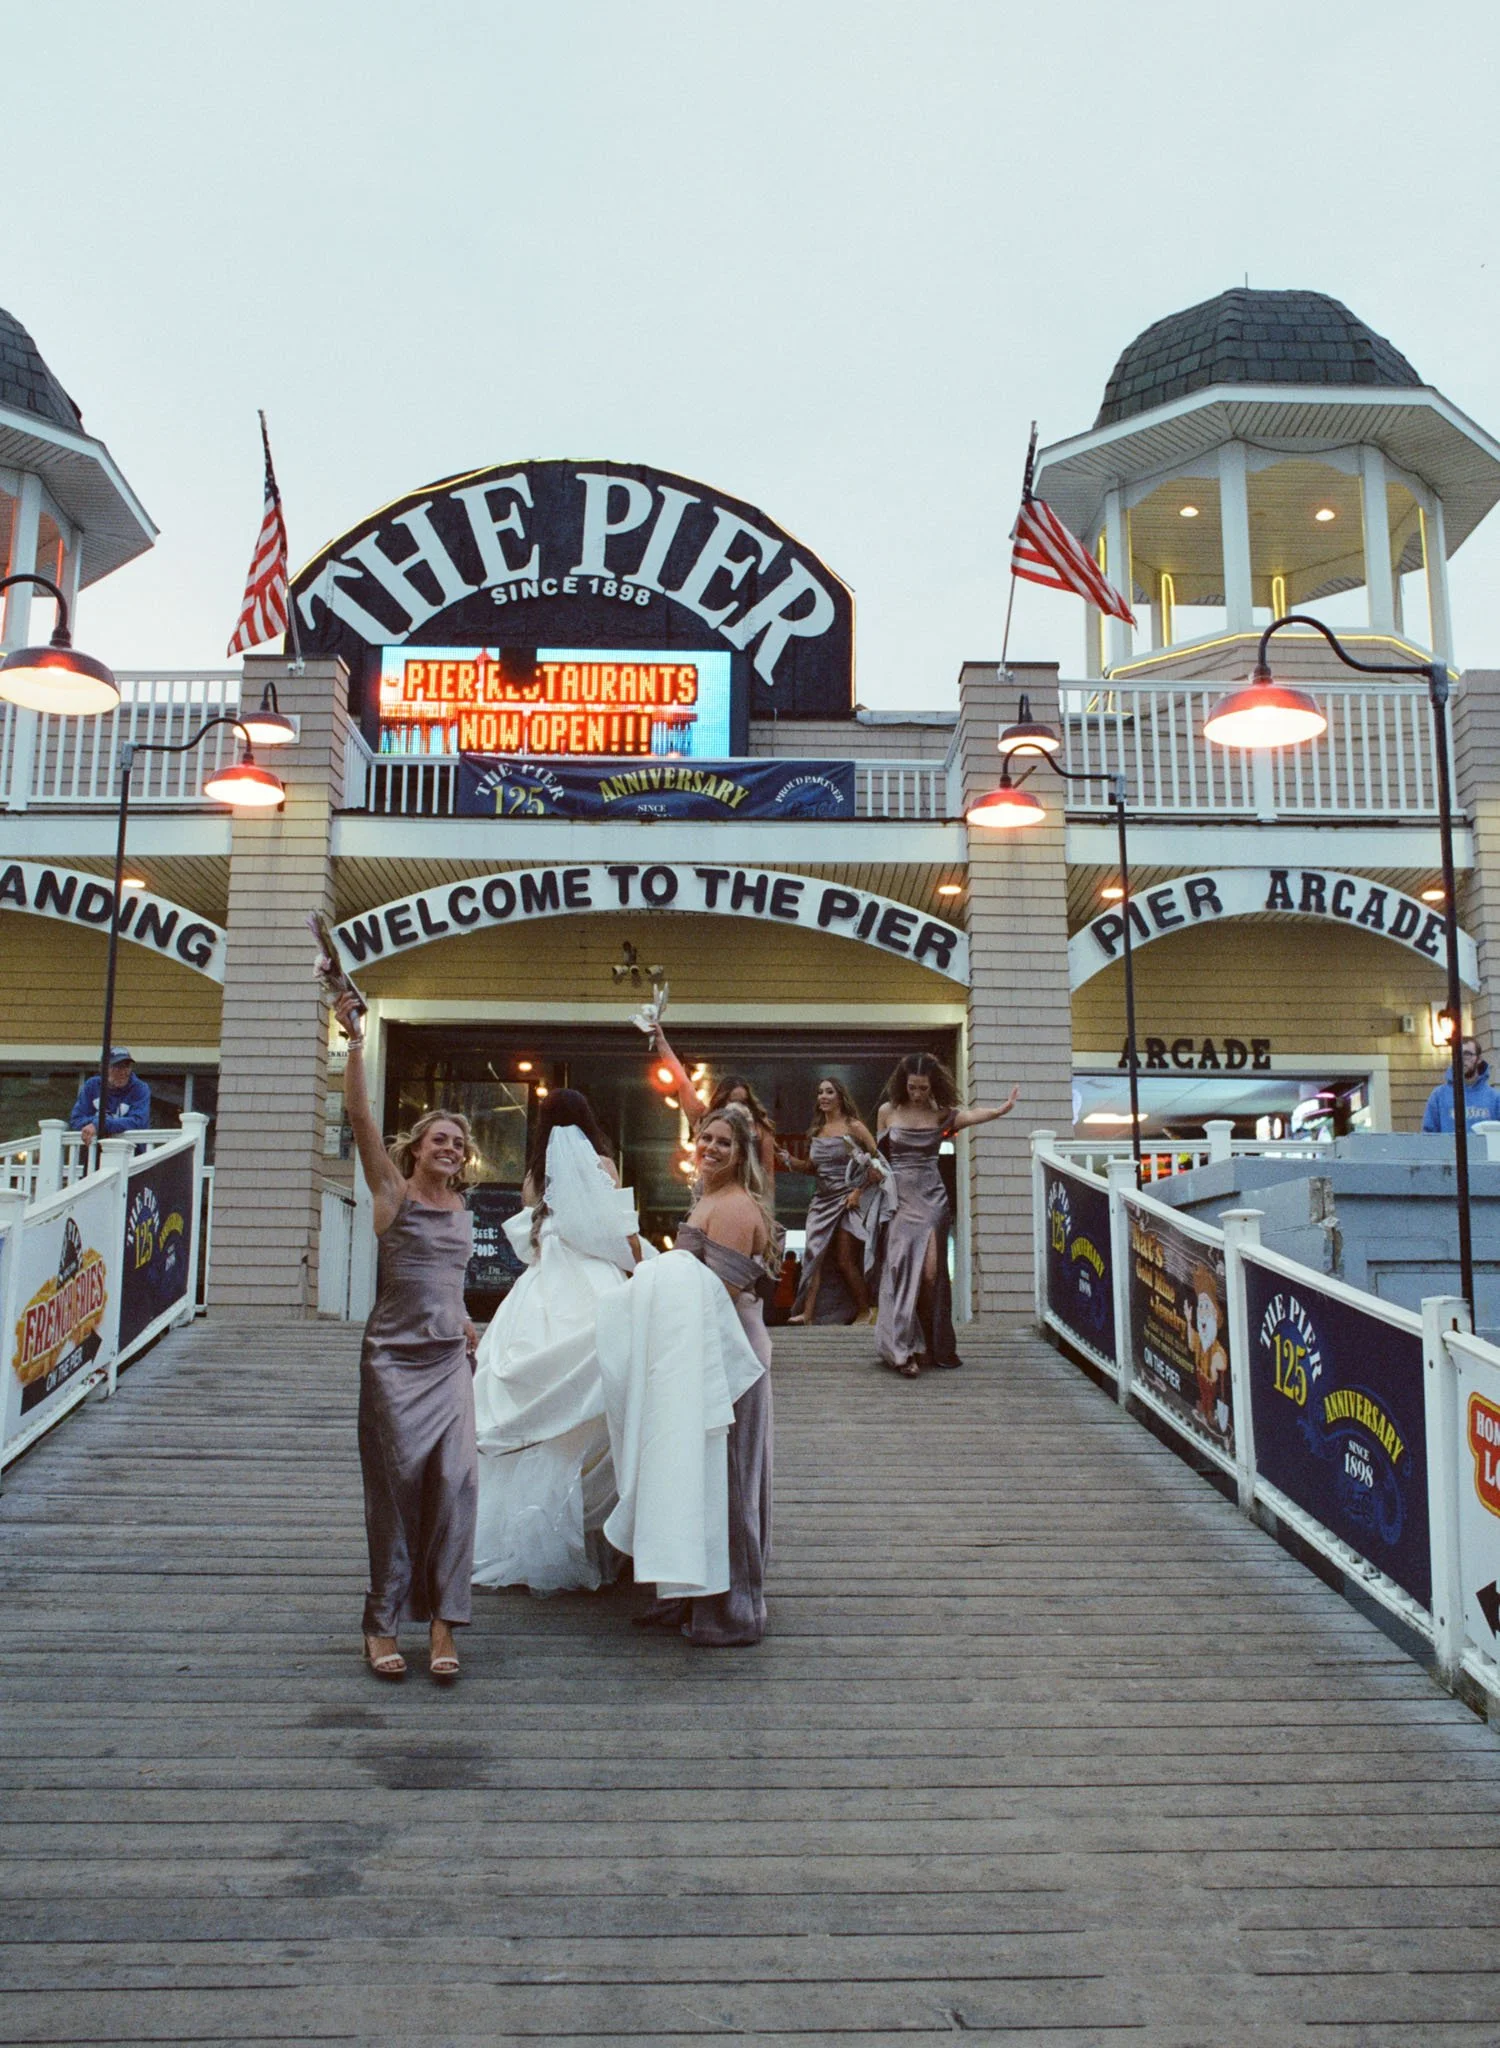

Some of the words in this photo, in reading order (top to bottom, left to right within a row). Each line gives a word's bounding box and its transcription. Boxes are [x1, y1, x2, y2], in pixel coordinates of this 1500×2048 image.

[297, 473, 540, 646] THE
[573, 473, 835, 685] PIER
[491, 576, 579, 605] SINCE
[588, 577, 651, 606] 1898
[407, 662, 477, 700] PIER
[487, 663, 697, 704] RTAURANTS
[460, 713, 520, 750] NOW
[531, 713, 648, 752] OPEN!!!
[475, 763, 513, 796] THE
[492, 784, 545, 815] 125
[598, 767, 749, 808] ANNIVERSARY
[637, 804, 668, 813] SINCE
[337, 867, 593, 963] WELCOME
[607, 865, 678, 905] TO
[696, 868, 805, 919] THE
[817, 888, 959, 970] PIER
[1091, 876, 1223, 957] PIER
[1265, 870, 1447, 957] ARCADE
[1118, 1037, 1271, 1070] ARCADE
[135, 1218, 153, 1270] 125
[22, 1281, 74, 1365] FRENCH
[74, 1258, 105, 1323] FRIES
[1260, 1294, 1286, 1350] THE
[1289, 1296, 1322, 1384] PIER
[1273, 1334, 1307, 1406] 125
[1324, 1390, 1404, 1465] ANNIVERSARY
[1344, 1452, 1374, 1489] 1898
[1348, 1440, 1370, 1461] SINCE
